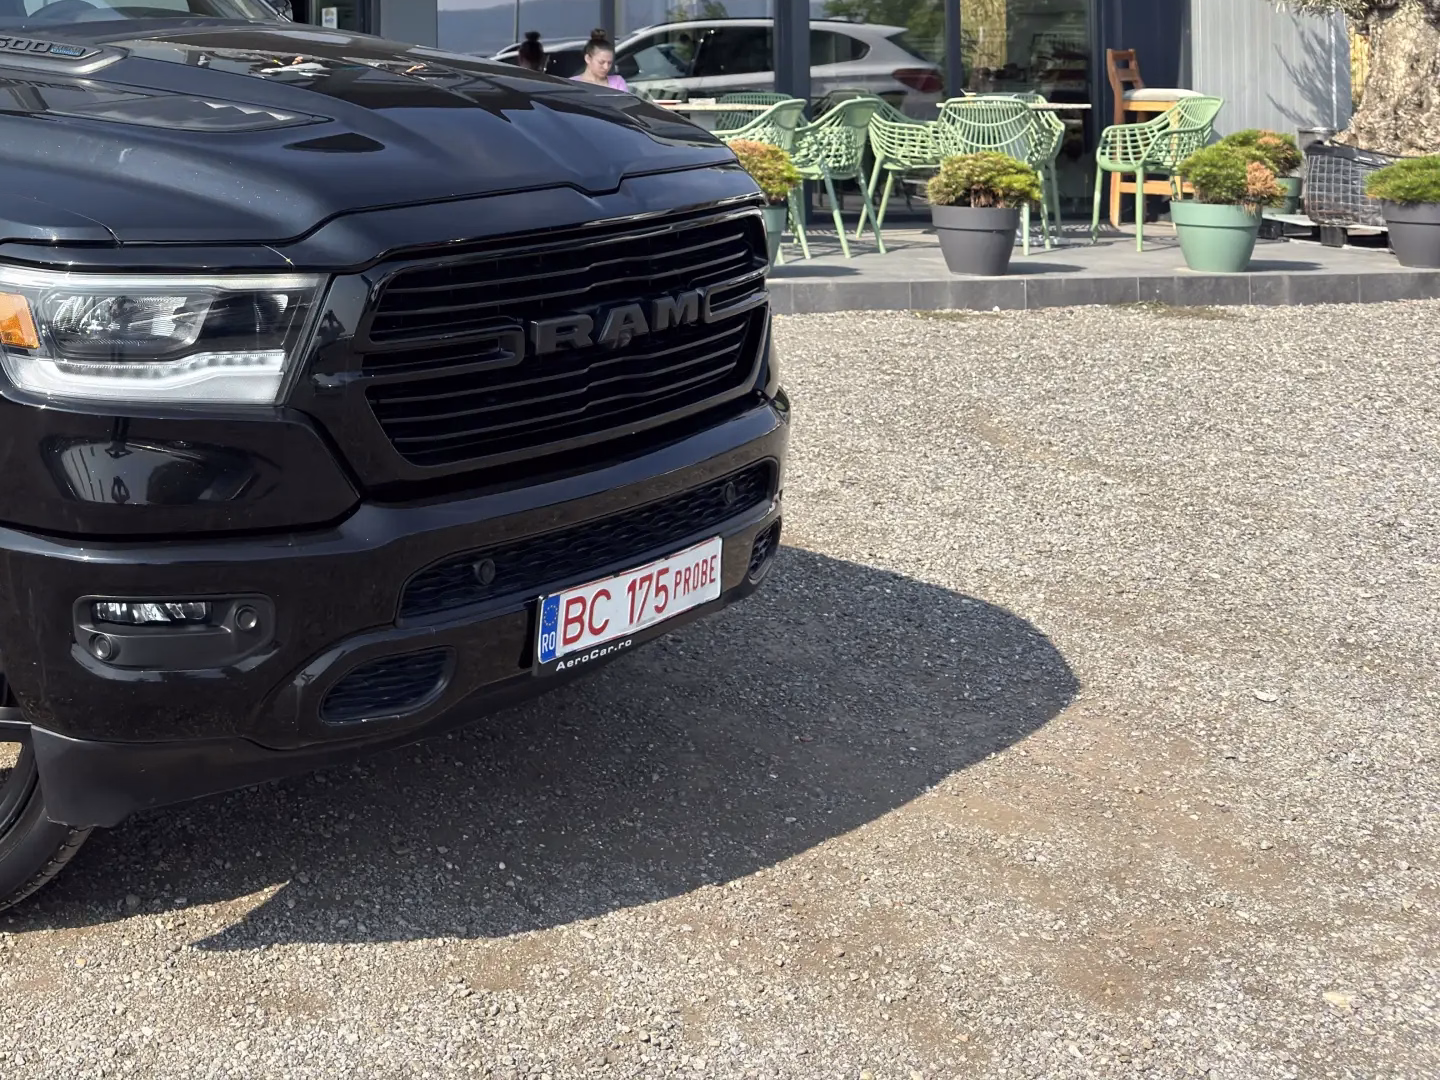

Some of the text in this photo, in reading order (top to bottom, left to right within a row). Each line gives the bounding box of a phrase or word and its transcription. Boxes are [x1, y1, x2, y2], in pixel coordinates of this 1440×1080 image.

[530, 288, 700, 356] RAM
[562, 554, 718, 647] BC 175 PROBE
[541, 631, 556, 654] RO
[556, 639, 632, 672] AeroCar.ro
